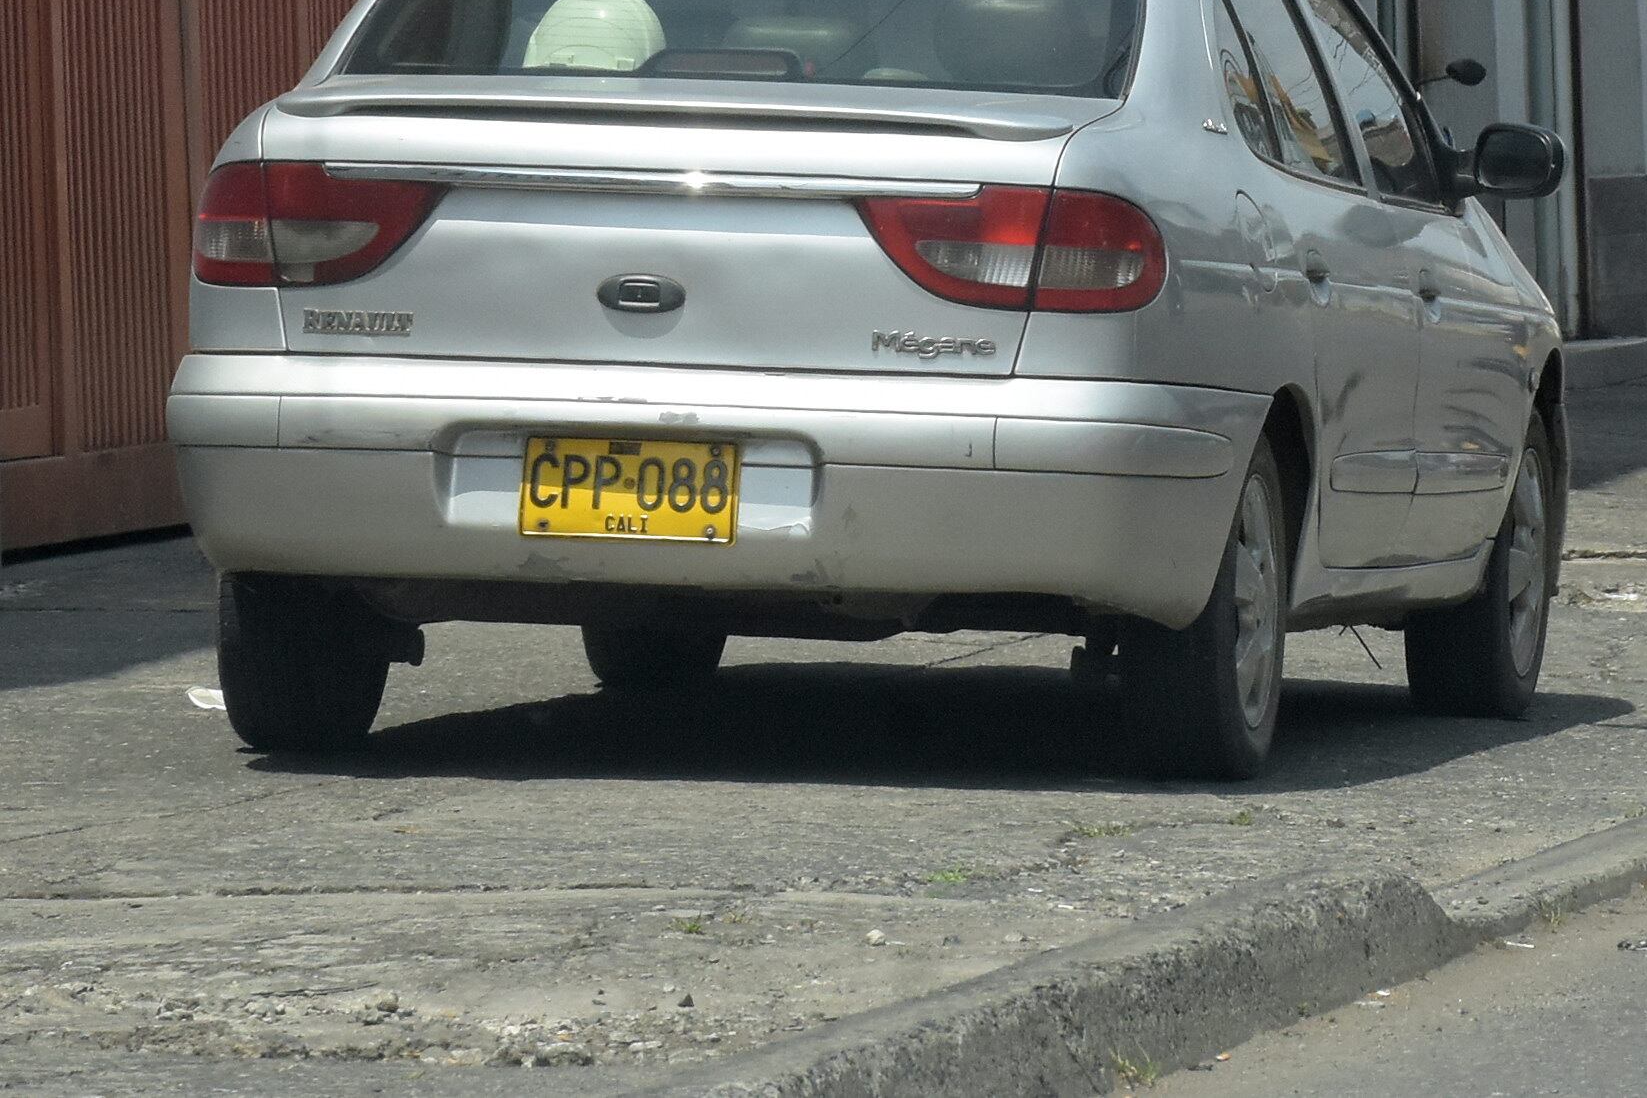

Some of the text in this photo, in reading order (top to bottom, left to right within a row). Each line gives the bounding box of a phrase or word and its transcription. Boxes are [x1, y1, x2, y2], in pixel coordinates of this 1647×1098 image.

[303, 307, 414, 336] RENAULT
[872, 329, 997, 360] Mégane
[604, 514, 649, 534] CALI
